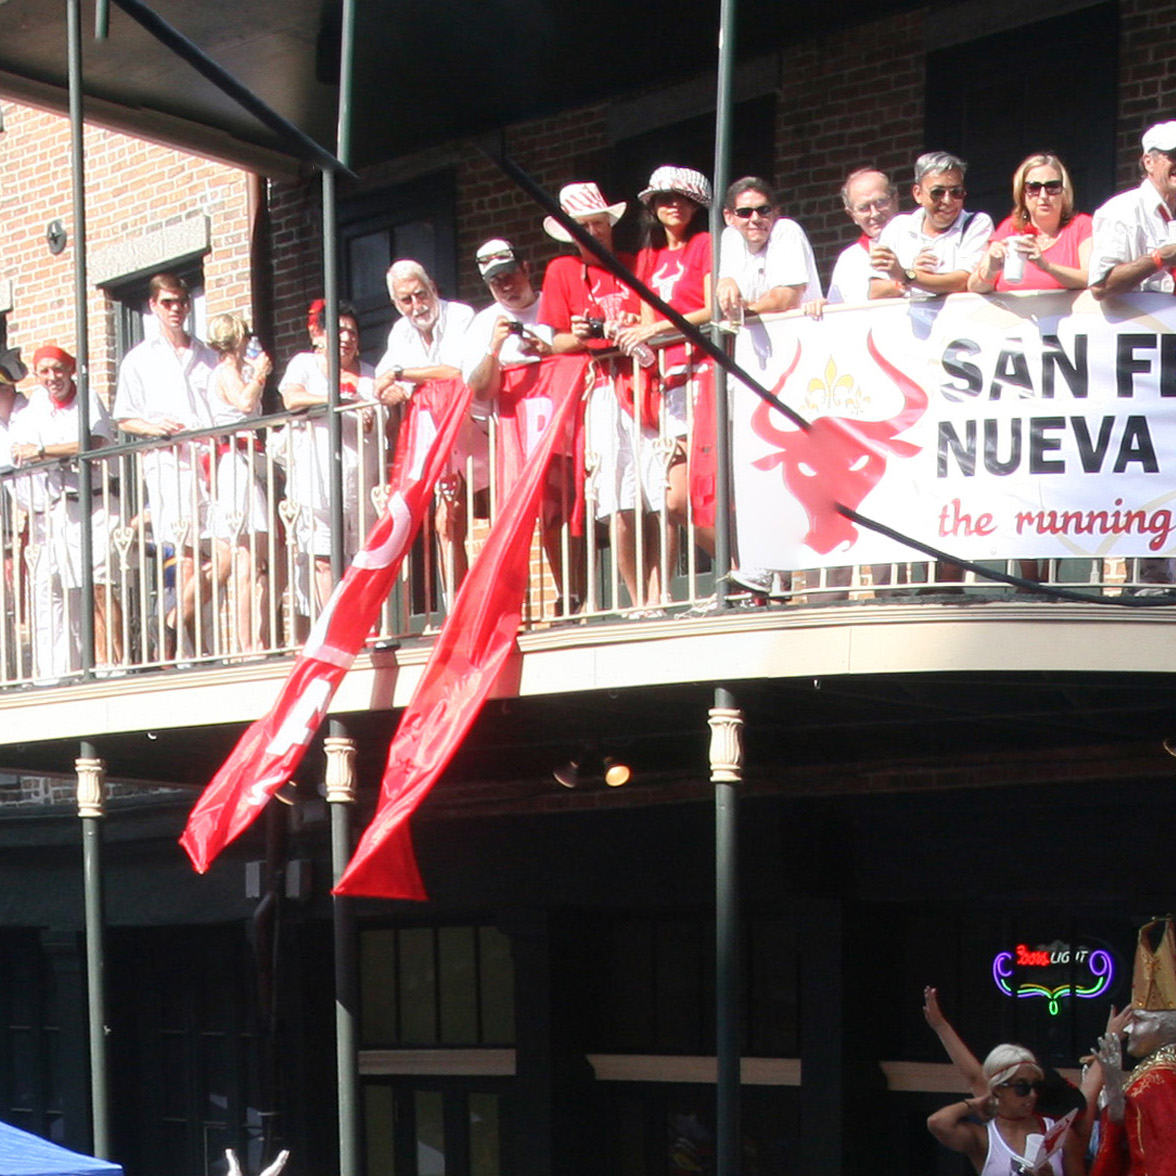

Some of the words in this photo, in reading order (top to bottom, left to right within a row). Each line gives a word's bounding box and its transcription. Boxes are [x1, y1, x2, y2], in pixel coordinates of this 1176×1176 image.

[940, 333, 1088, 402] SAN
[937, 415, 1160, 478] NUEVA
[938, 498, 998, 537] the
